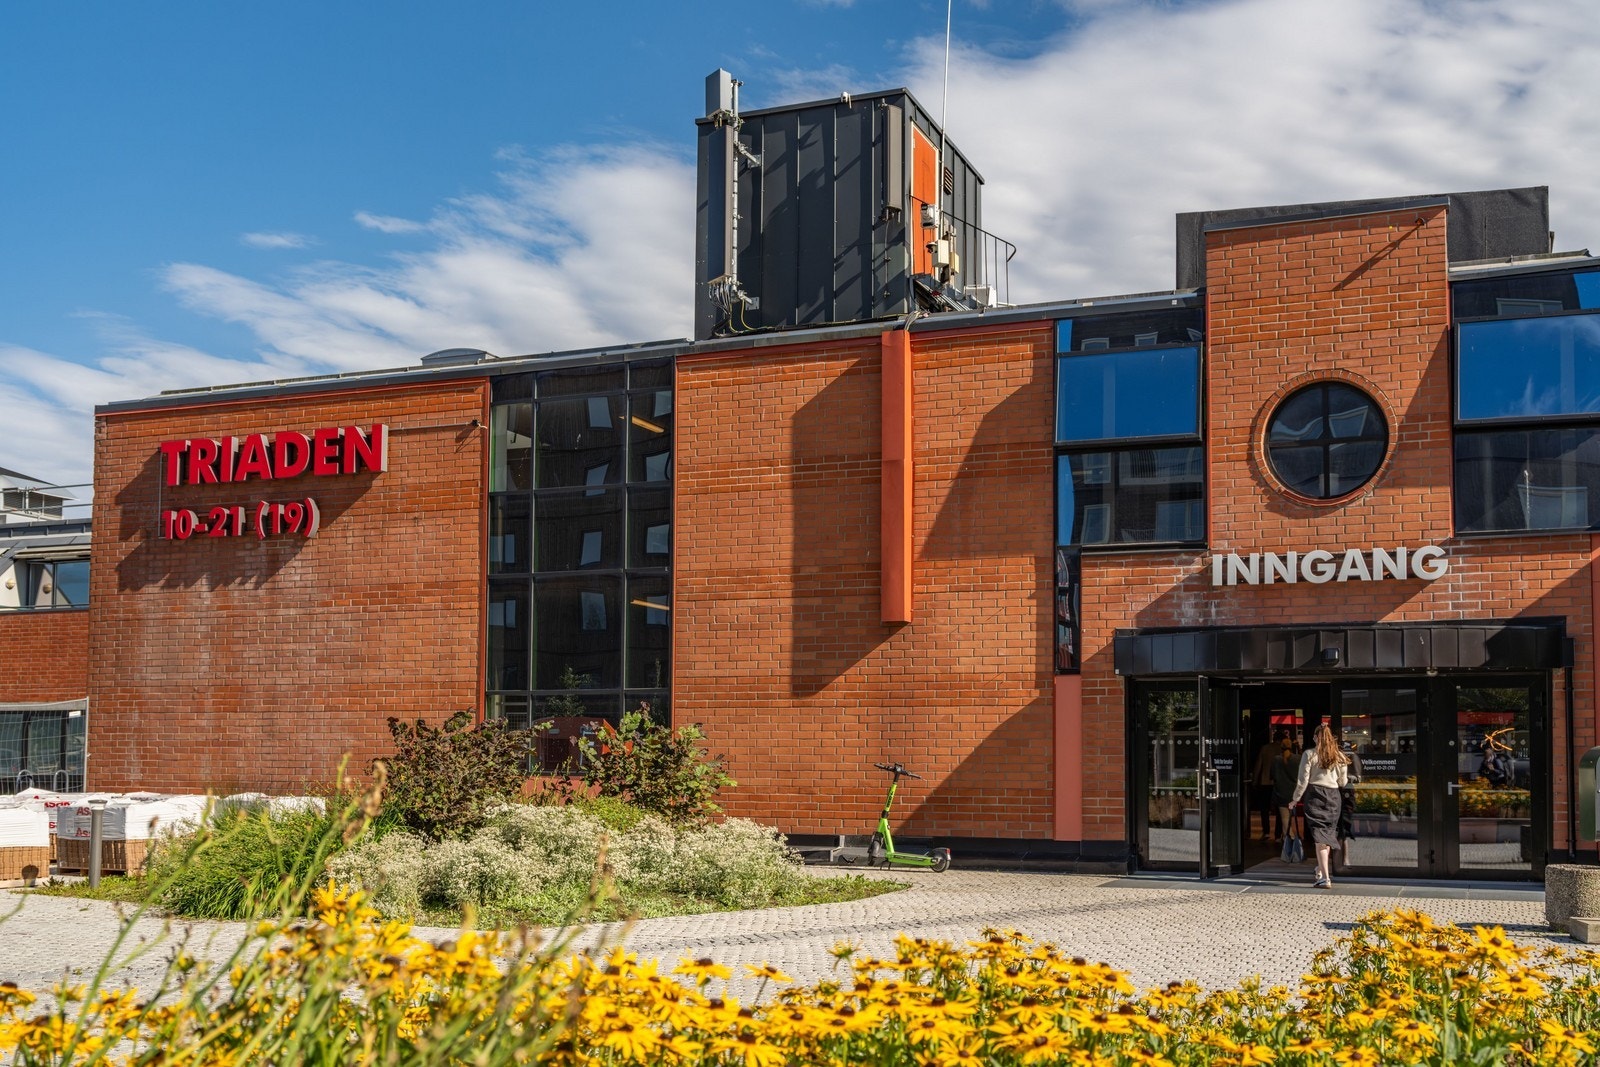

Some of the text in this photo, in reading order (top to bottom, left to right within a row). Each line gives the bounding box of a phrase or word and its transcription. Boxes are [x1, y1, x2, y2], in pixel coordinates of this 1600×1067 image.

[161, 424, 388, 486] TRIADEN
[162, 498, 320, 540] 10-21 (19)
[1212, 545, 1449, 586] INNGANG
